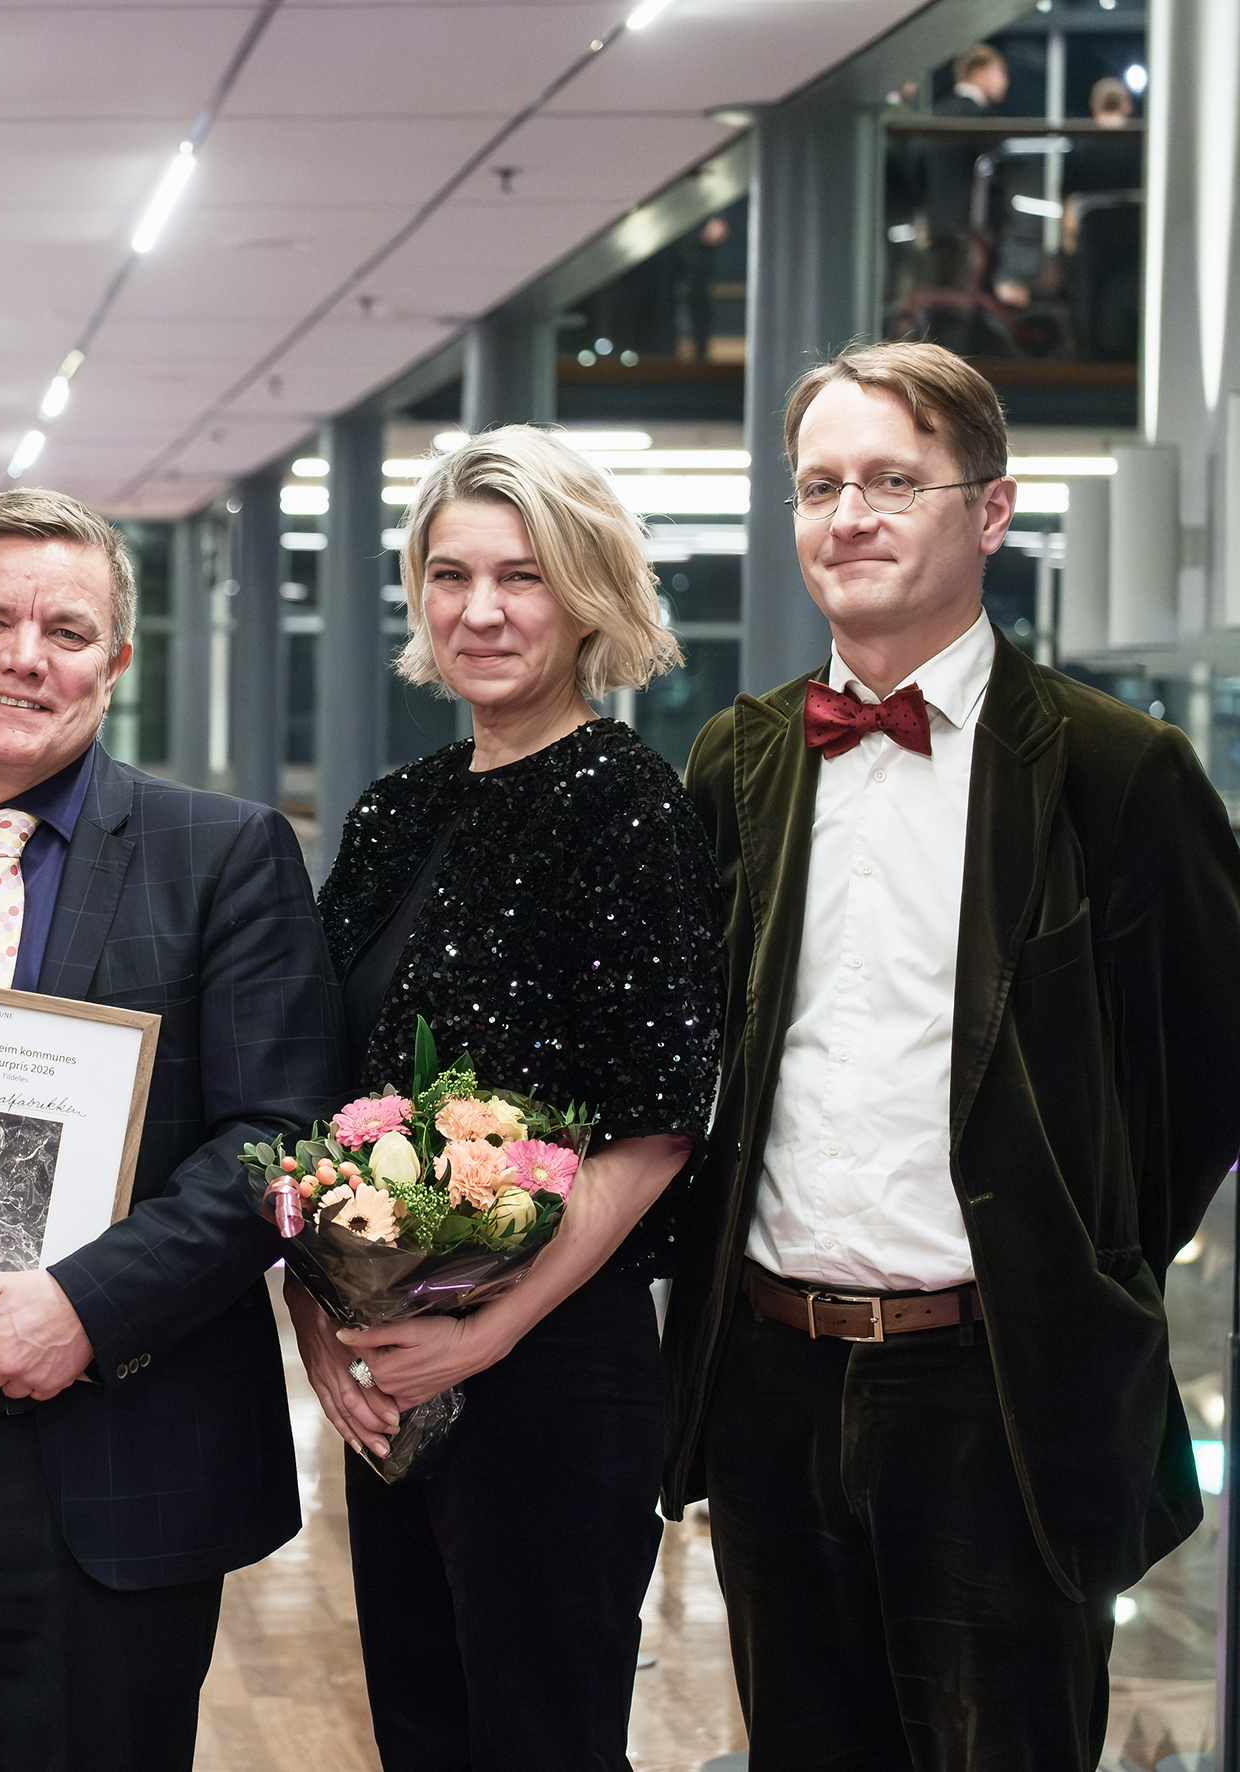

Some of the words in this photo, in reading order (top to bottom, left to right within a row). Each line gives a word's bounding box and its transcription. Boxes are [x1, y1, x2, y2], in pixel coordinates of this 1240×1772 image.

[20, 1046, 77, 1064] kommunes
[30, 1064, 55, 1076] 2026
[2, 1072, 29, 1083] Tildeles
